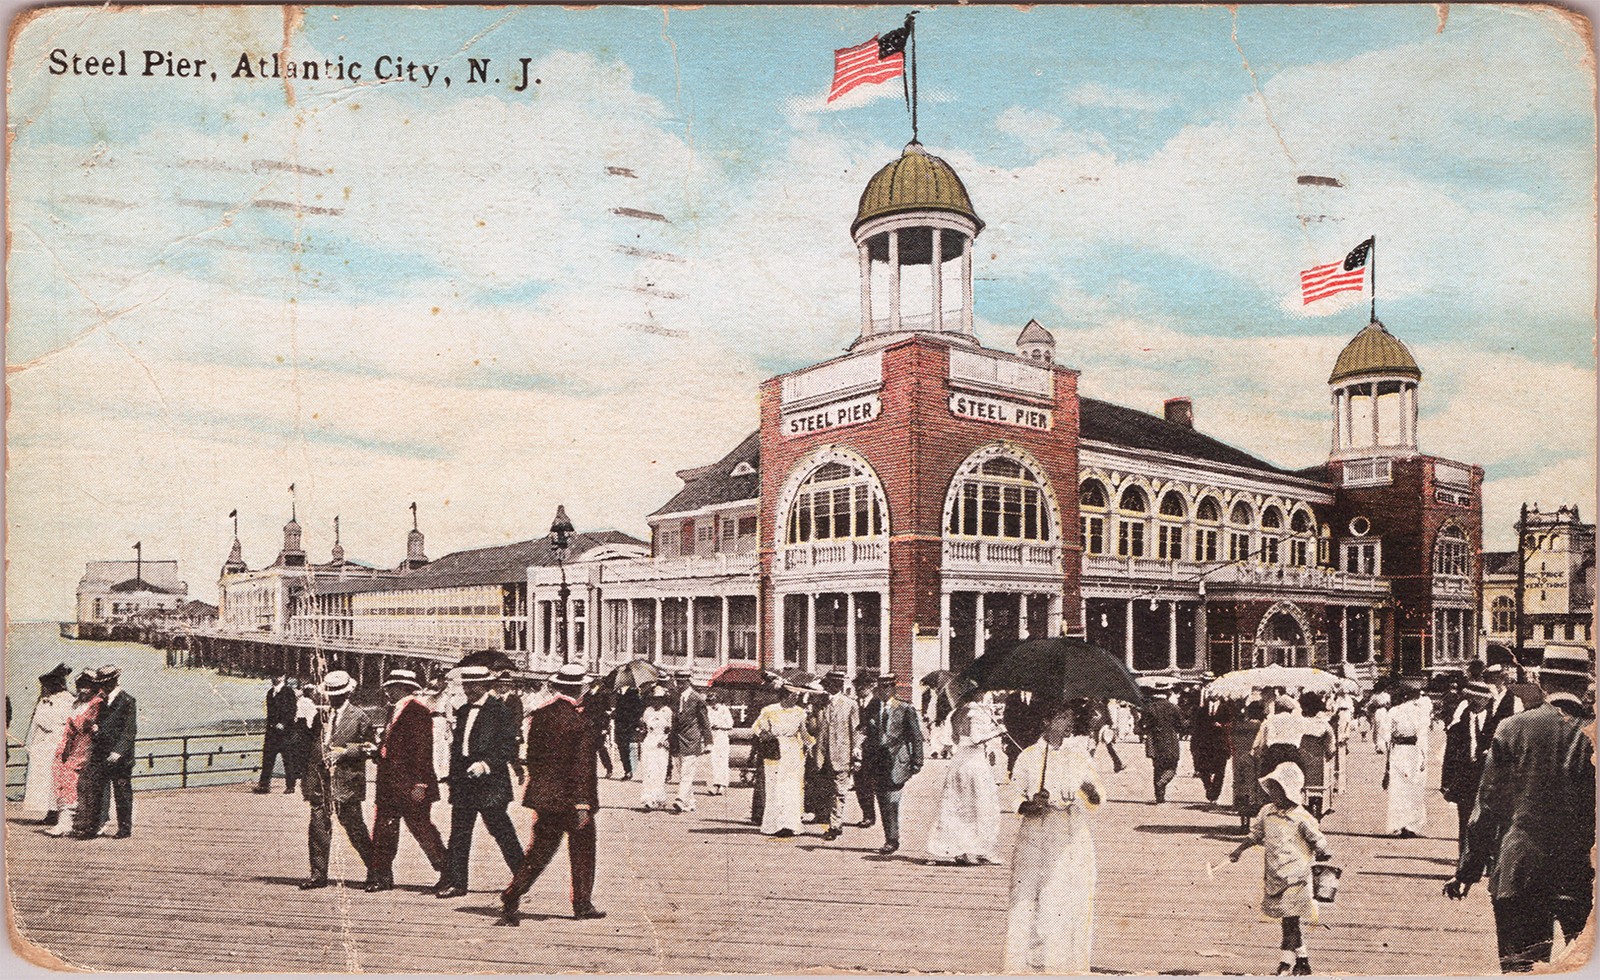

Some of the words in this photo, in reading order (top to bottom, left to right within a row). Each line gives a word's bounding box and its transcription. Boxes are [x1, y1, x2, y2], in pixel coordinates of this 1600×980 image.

[790, 411, 833, 433] STEEL
[837, 402, 872, 424] PIER
[957, 397, 1007, 421] STEEL
[1016, 408, 1048, 429] PIER
